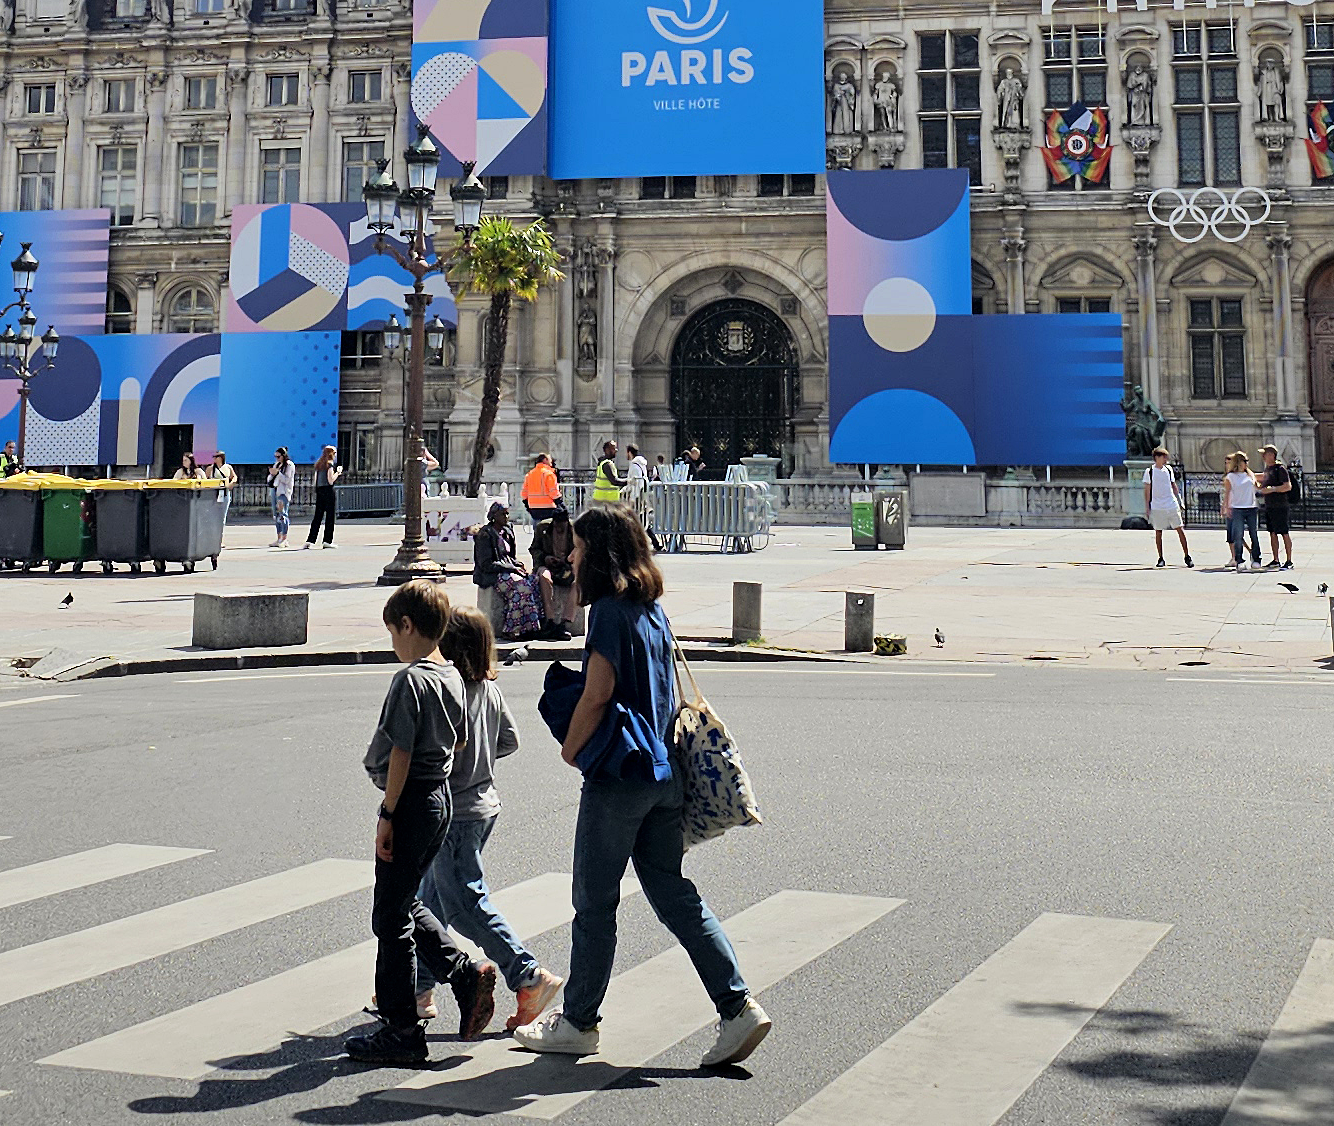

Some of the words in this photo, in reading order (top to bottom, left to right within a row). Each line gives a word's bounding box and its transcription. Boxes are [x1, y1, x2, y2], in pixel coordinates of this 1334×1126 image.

[621, 47, 755, 87] PARIS
[653, 99, 686, 111] VILLE
[688, 96, 721, 110] HÔTE
